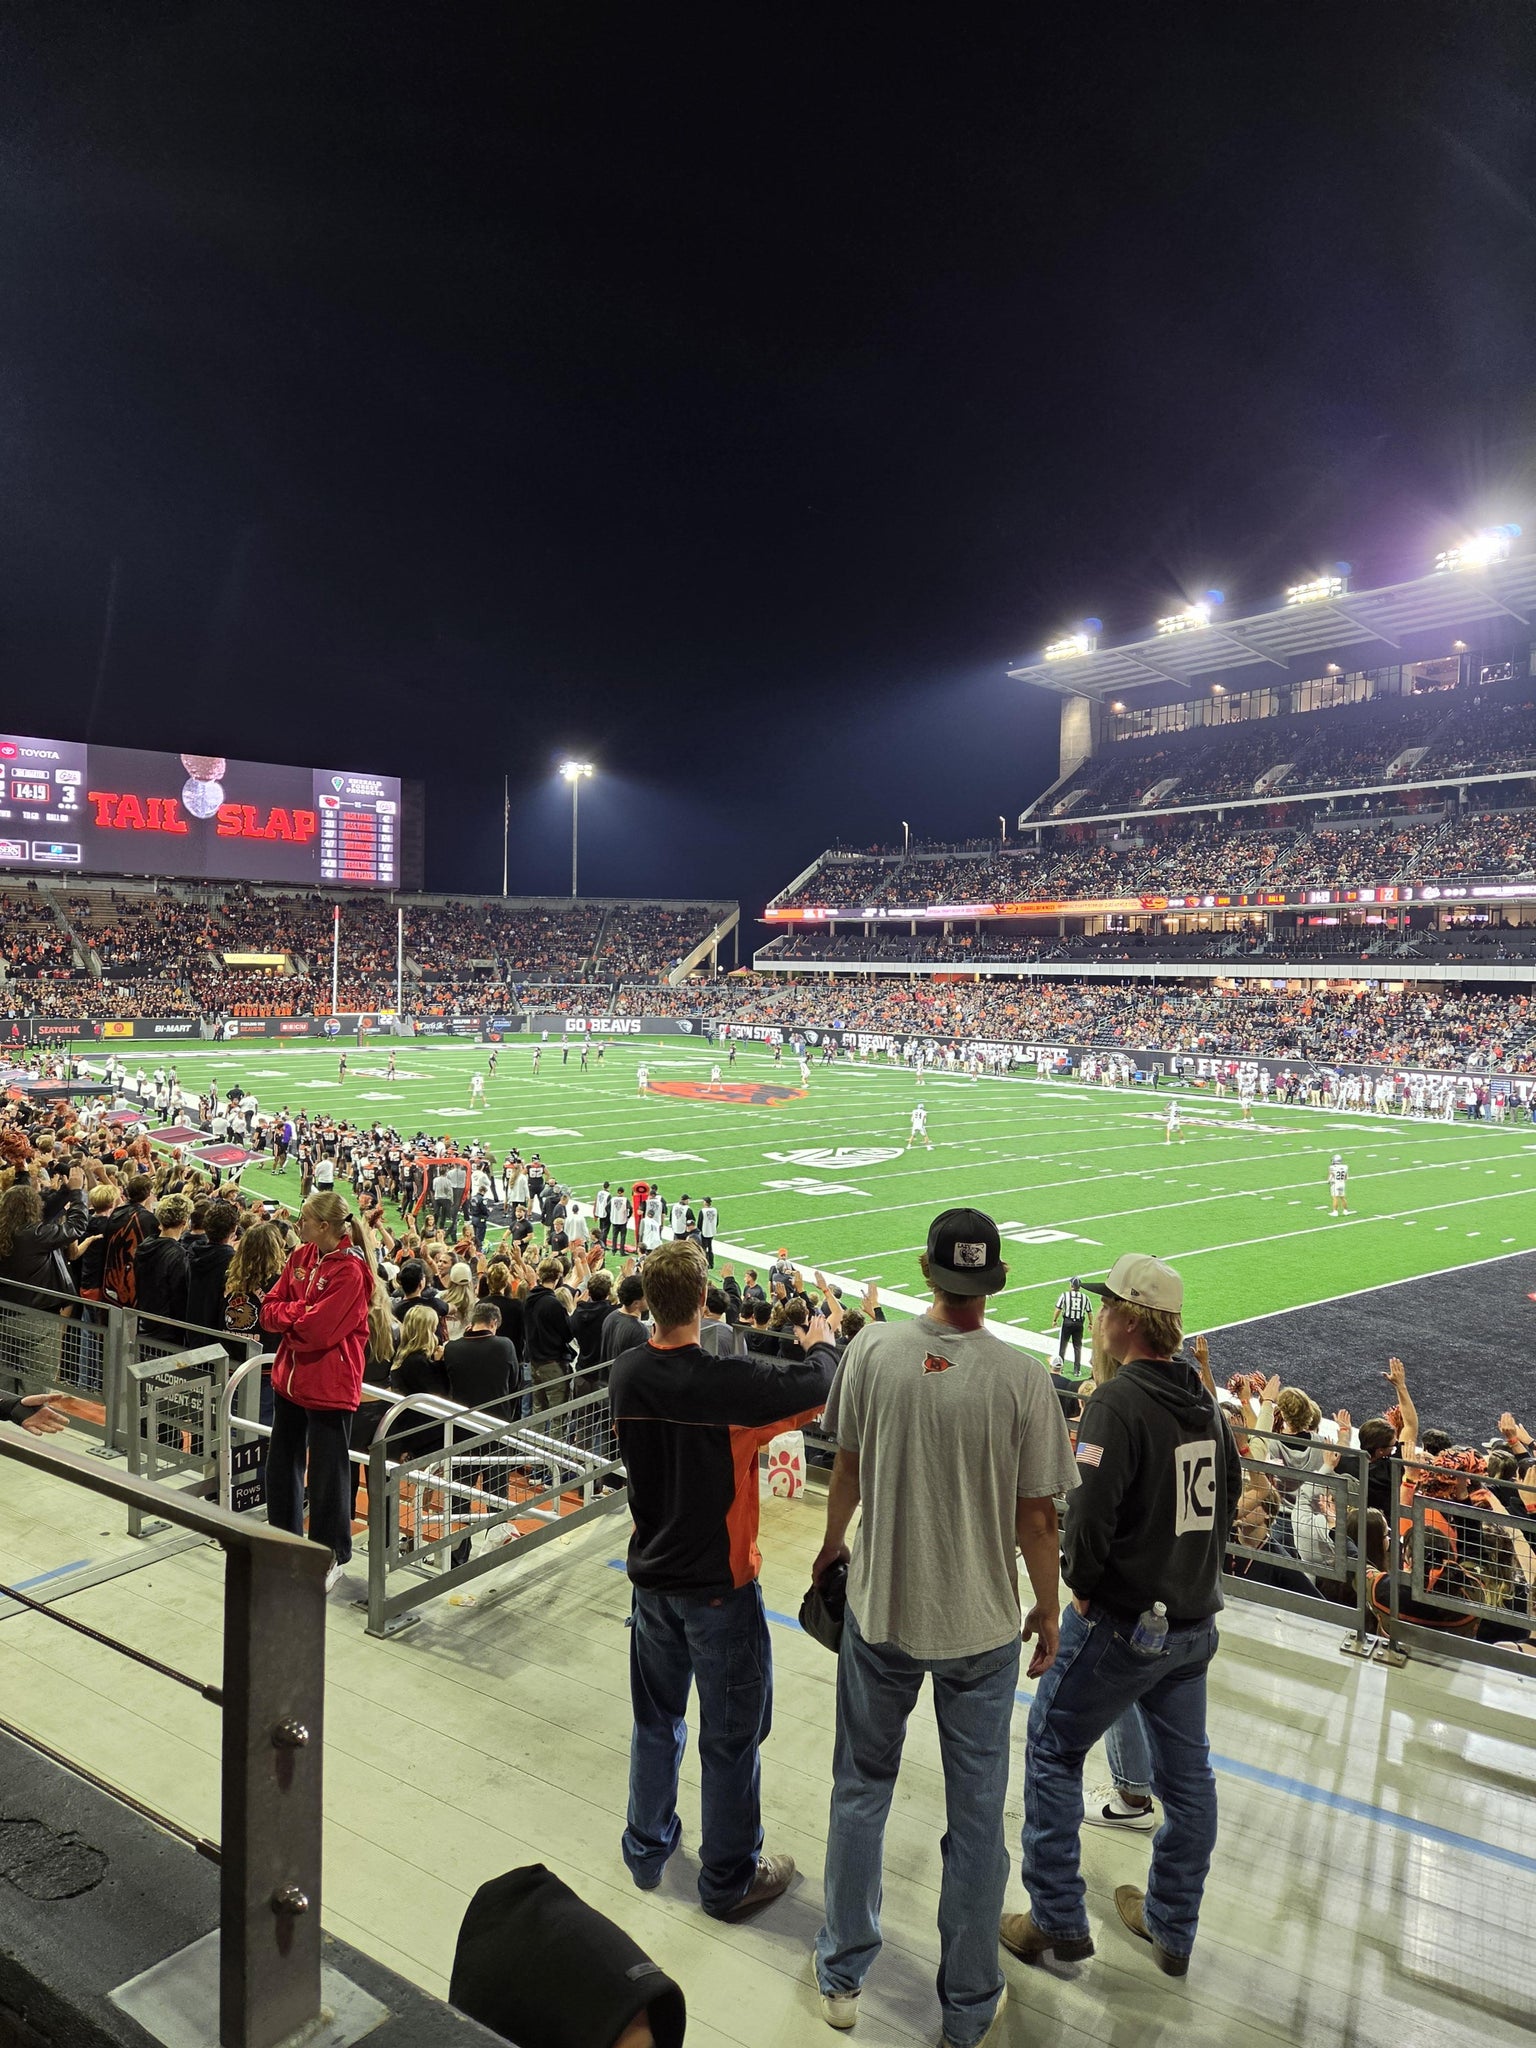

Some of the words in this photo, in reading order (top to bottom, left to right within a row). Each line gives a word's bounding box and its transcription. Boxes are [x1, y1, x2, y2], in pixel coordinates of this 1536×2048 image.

[19, 748, 60, 759] TOYOTA
[62, 786, 75, 802] 3
[88, 791, 189, 833] TAIL
[216, 803, 316, 842] SLAP
[154, 1024, 192, 1033] BI-MART
[565, 1018, 586, 1032] GO
[588, 1018, 641, 1033] BEAVS
[529, 1167, 544, 1178] 62
[235, 1446, 261, 1468] 111
[236, 1485, 261, 1499] Rows
[237, 1501, 241, 1509] 1
[250, 1494, 260, 1505] 14
